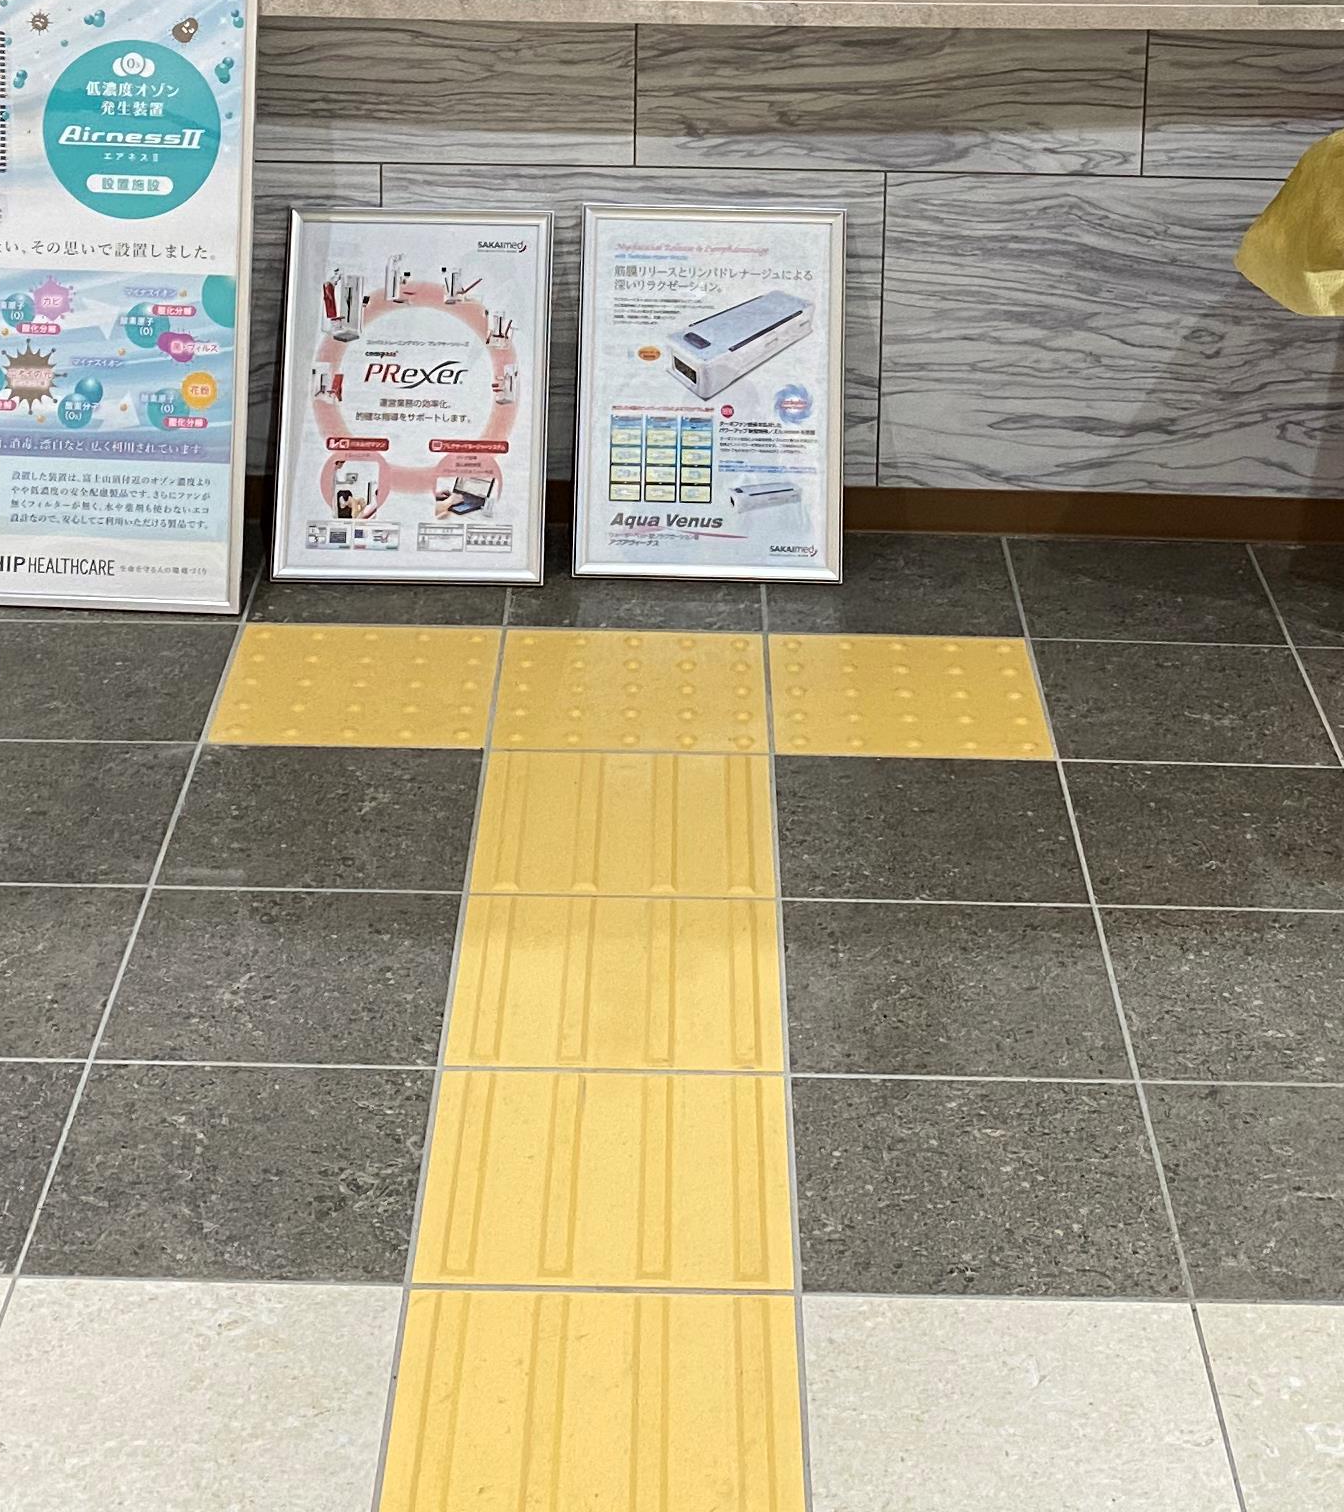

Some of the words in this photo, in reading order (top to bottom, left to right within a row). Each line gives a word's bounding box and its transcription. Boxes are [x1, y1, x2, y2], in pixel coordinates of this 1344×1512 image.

[85, 80, 180, 98] 低濃度オゾン
[101, 100, 164, 117] 発生装置
[101, 177, 160, 192] 設置施設
[610, 512, 660, 529] Aqua
[665, 514, 724, 529] Venus
